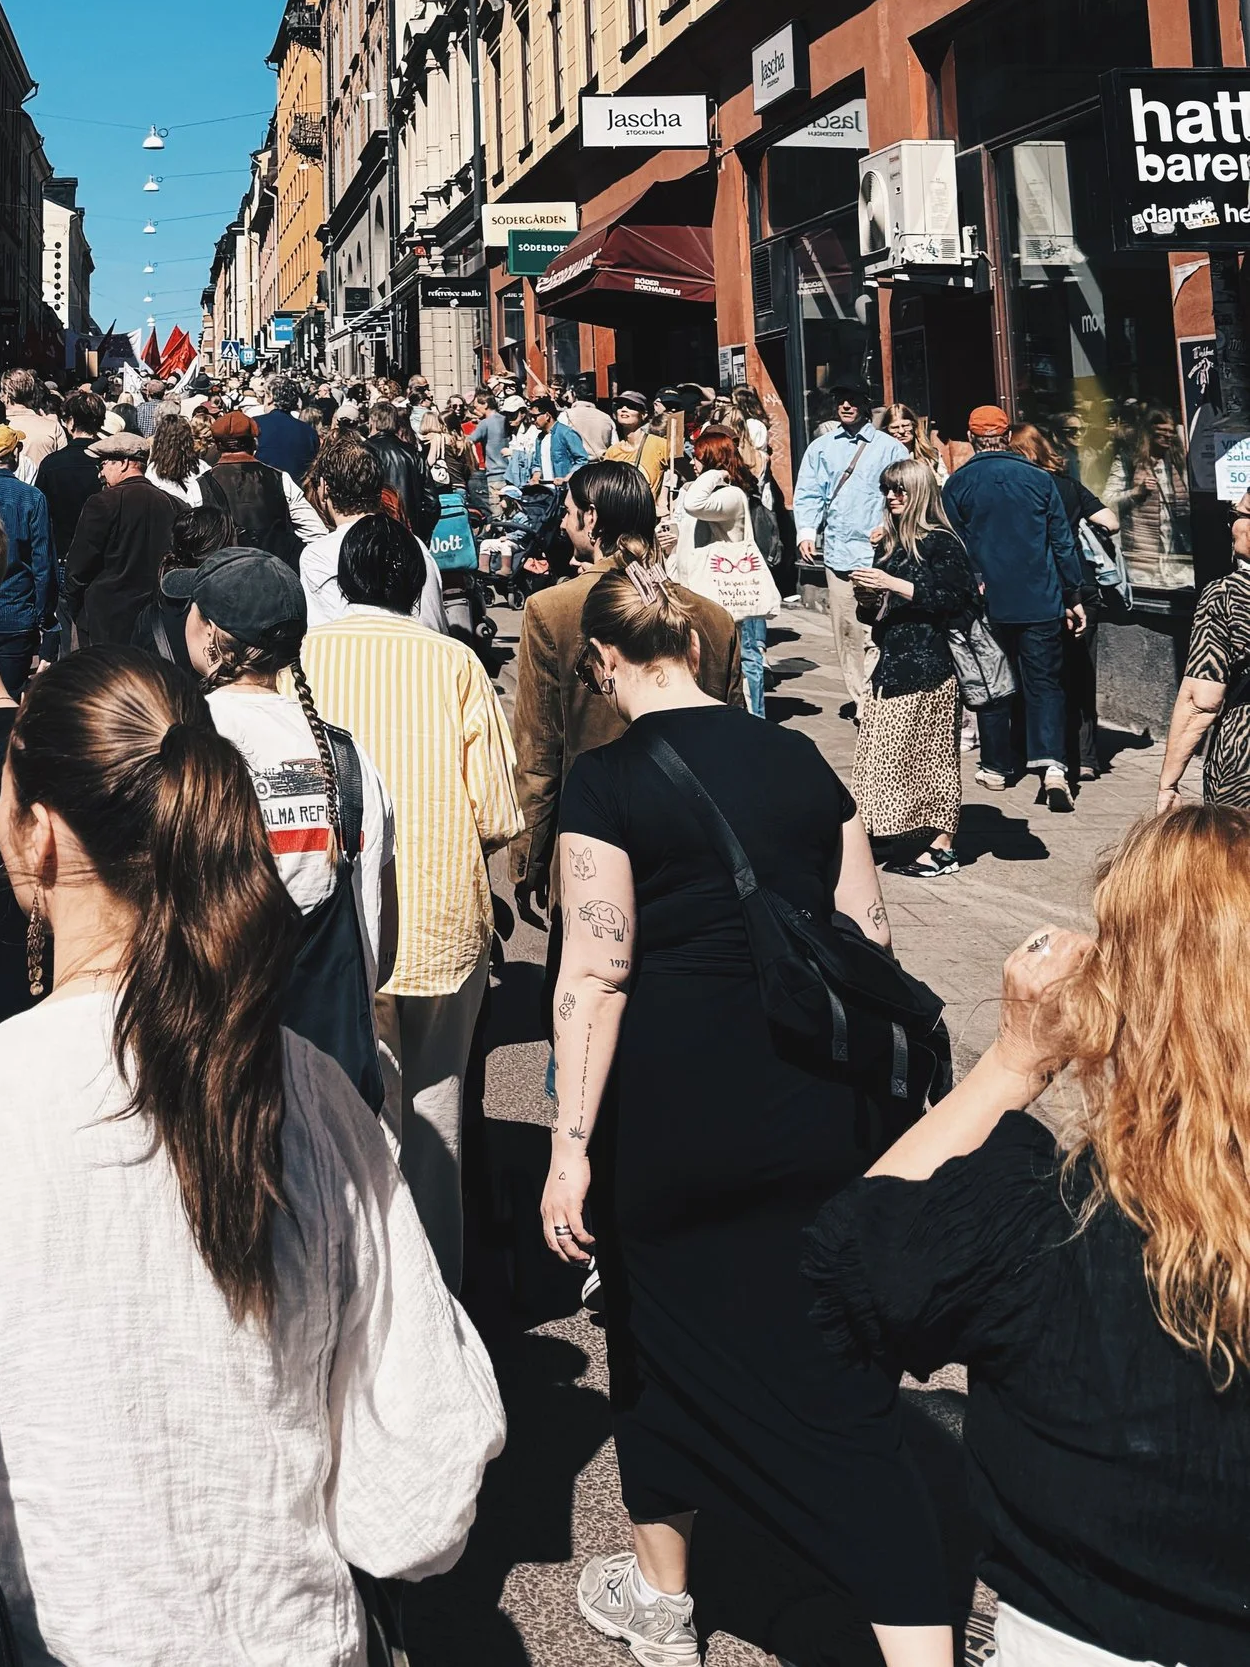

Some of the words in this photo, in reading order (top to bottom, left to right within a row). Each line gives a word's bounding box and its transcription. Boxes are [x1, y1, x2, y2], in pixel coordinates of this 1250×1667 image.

[761, 50, 785, 86] Jascha
[607, 108, 682, 130] Jascha
[492, 214, 567, 225] SÖDERGÅRDEN
[634, 277, 660, 286] SÖDER
[427, 288, 460, 298] reference
[461, 288, 482, 297] audio
[634, 283, 681, 295] BOKHANDELN
[610, 958, 630, 969] 1972
